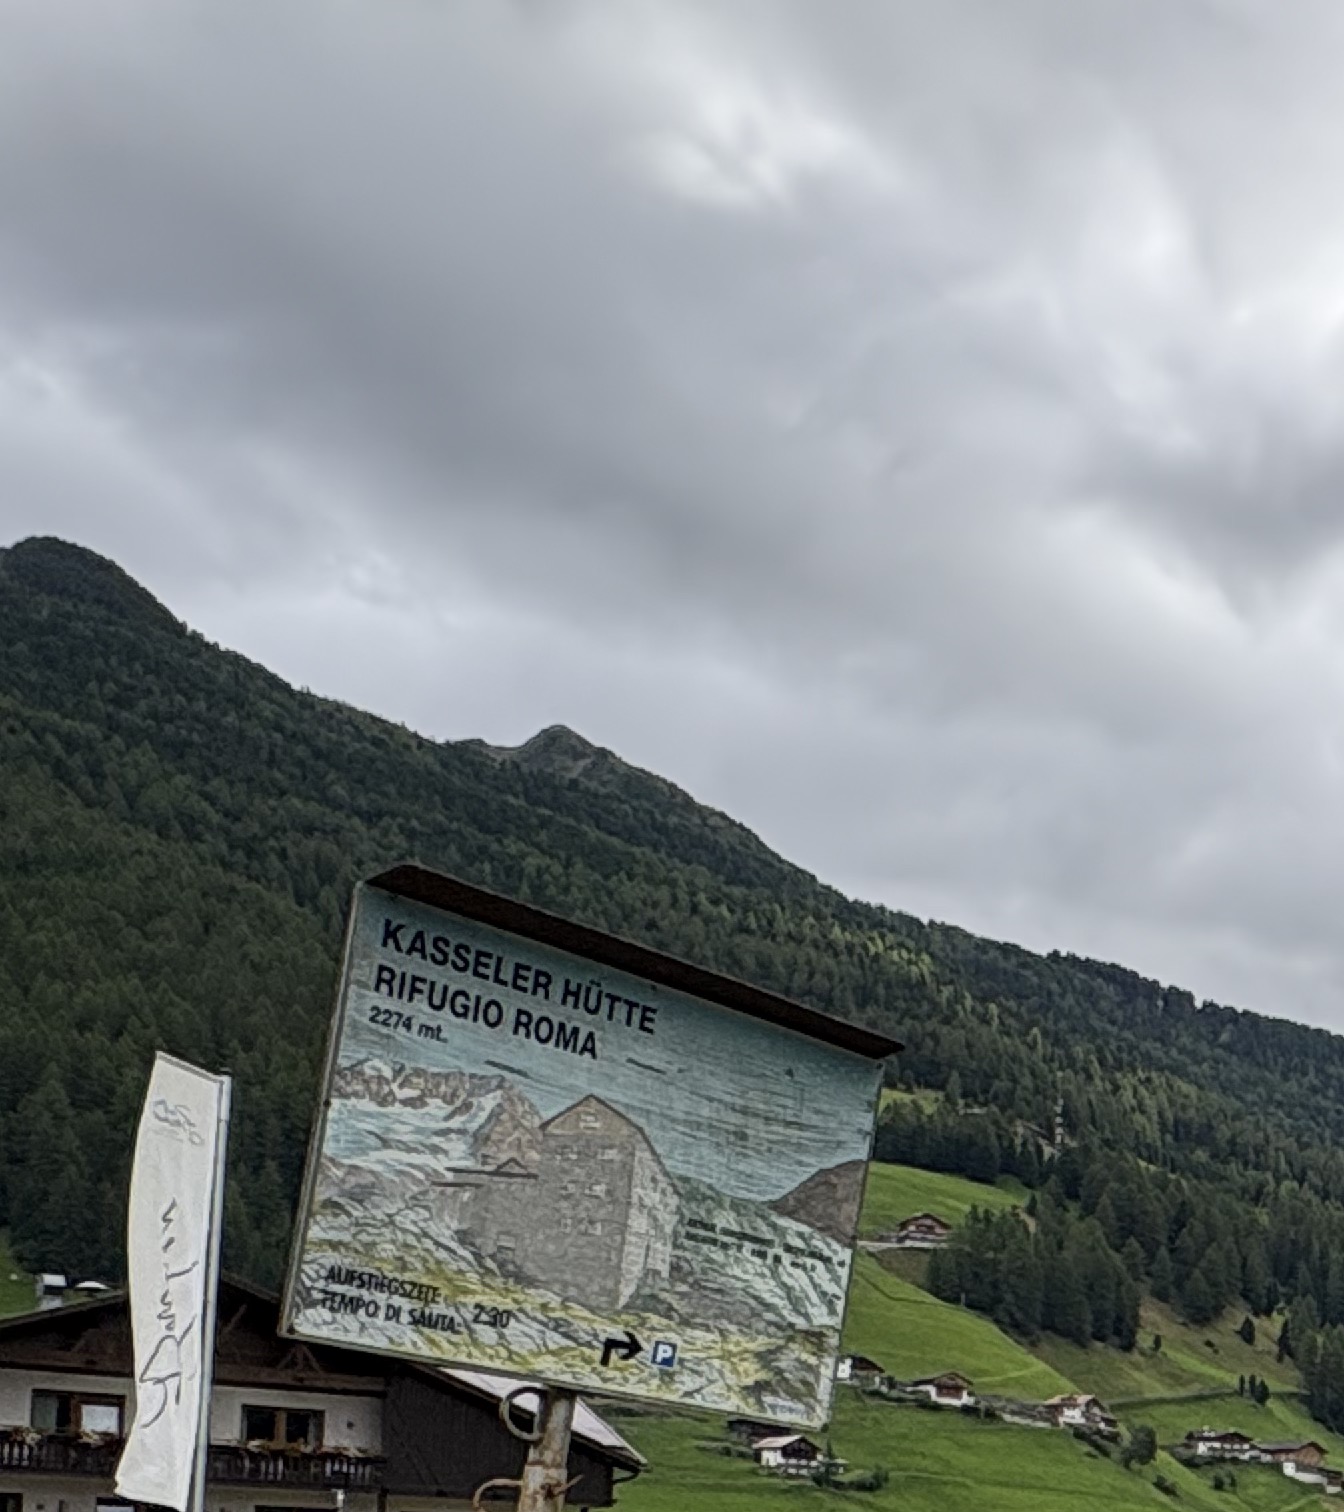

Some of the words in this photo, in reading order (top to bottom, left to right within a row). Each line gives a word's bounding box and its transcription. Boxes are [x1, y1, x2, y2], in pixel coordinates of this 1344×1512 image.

[381, 918, 552, 1000] KASSELER
[561, 978, 658, 1035] HÜTTE
[368, 1004, 414, 1034] 2274
[374, 964, 504, 1029] RIFUGIO
[512, 1008, 598, 1060] ROMA
[384, 1303, 401, 1323] DI
